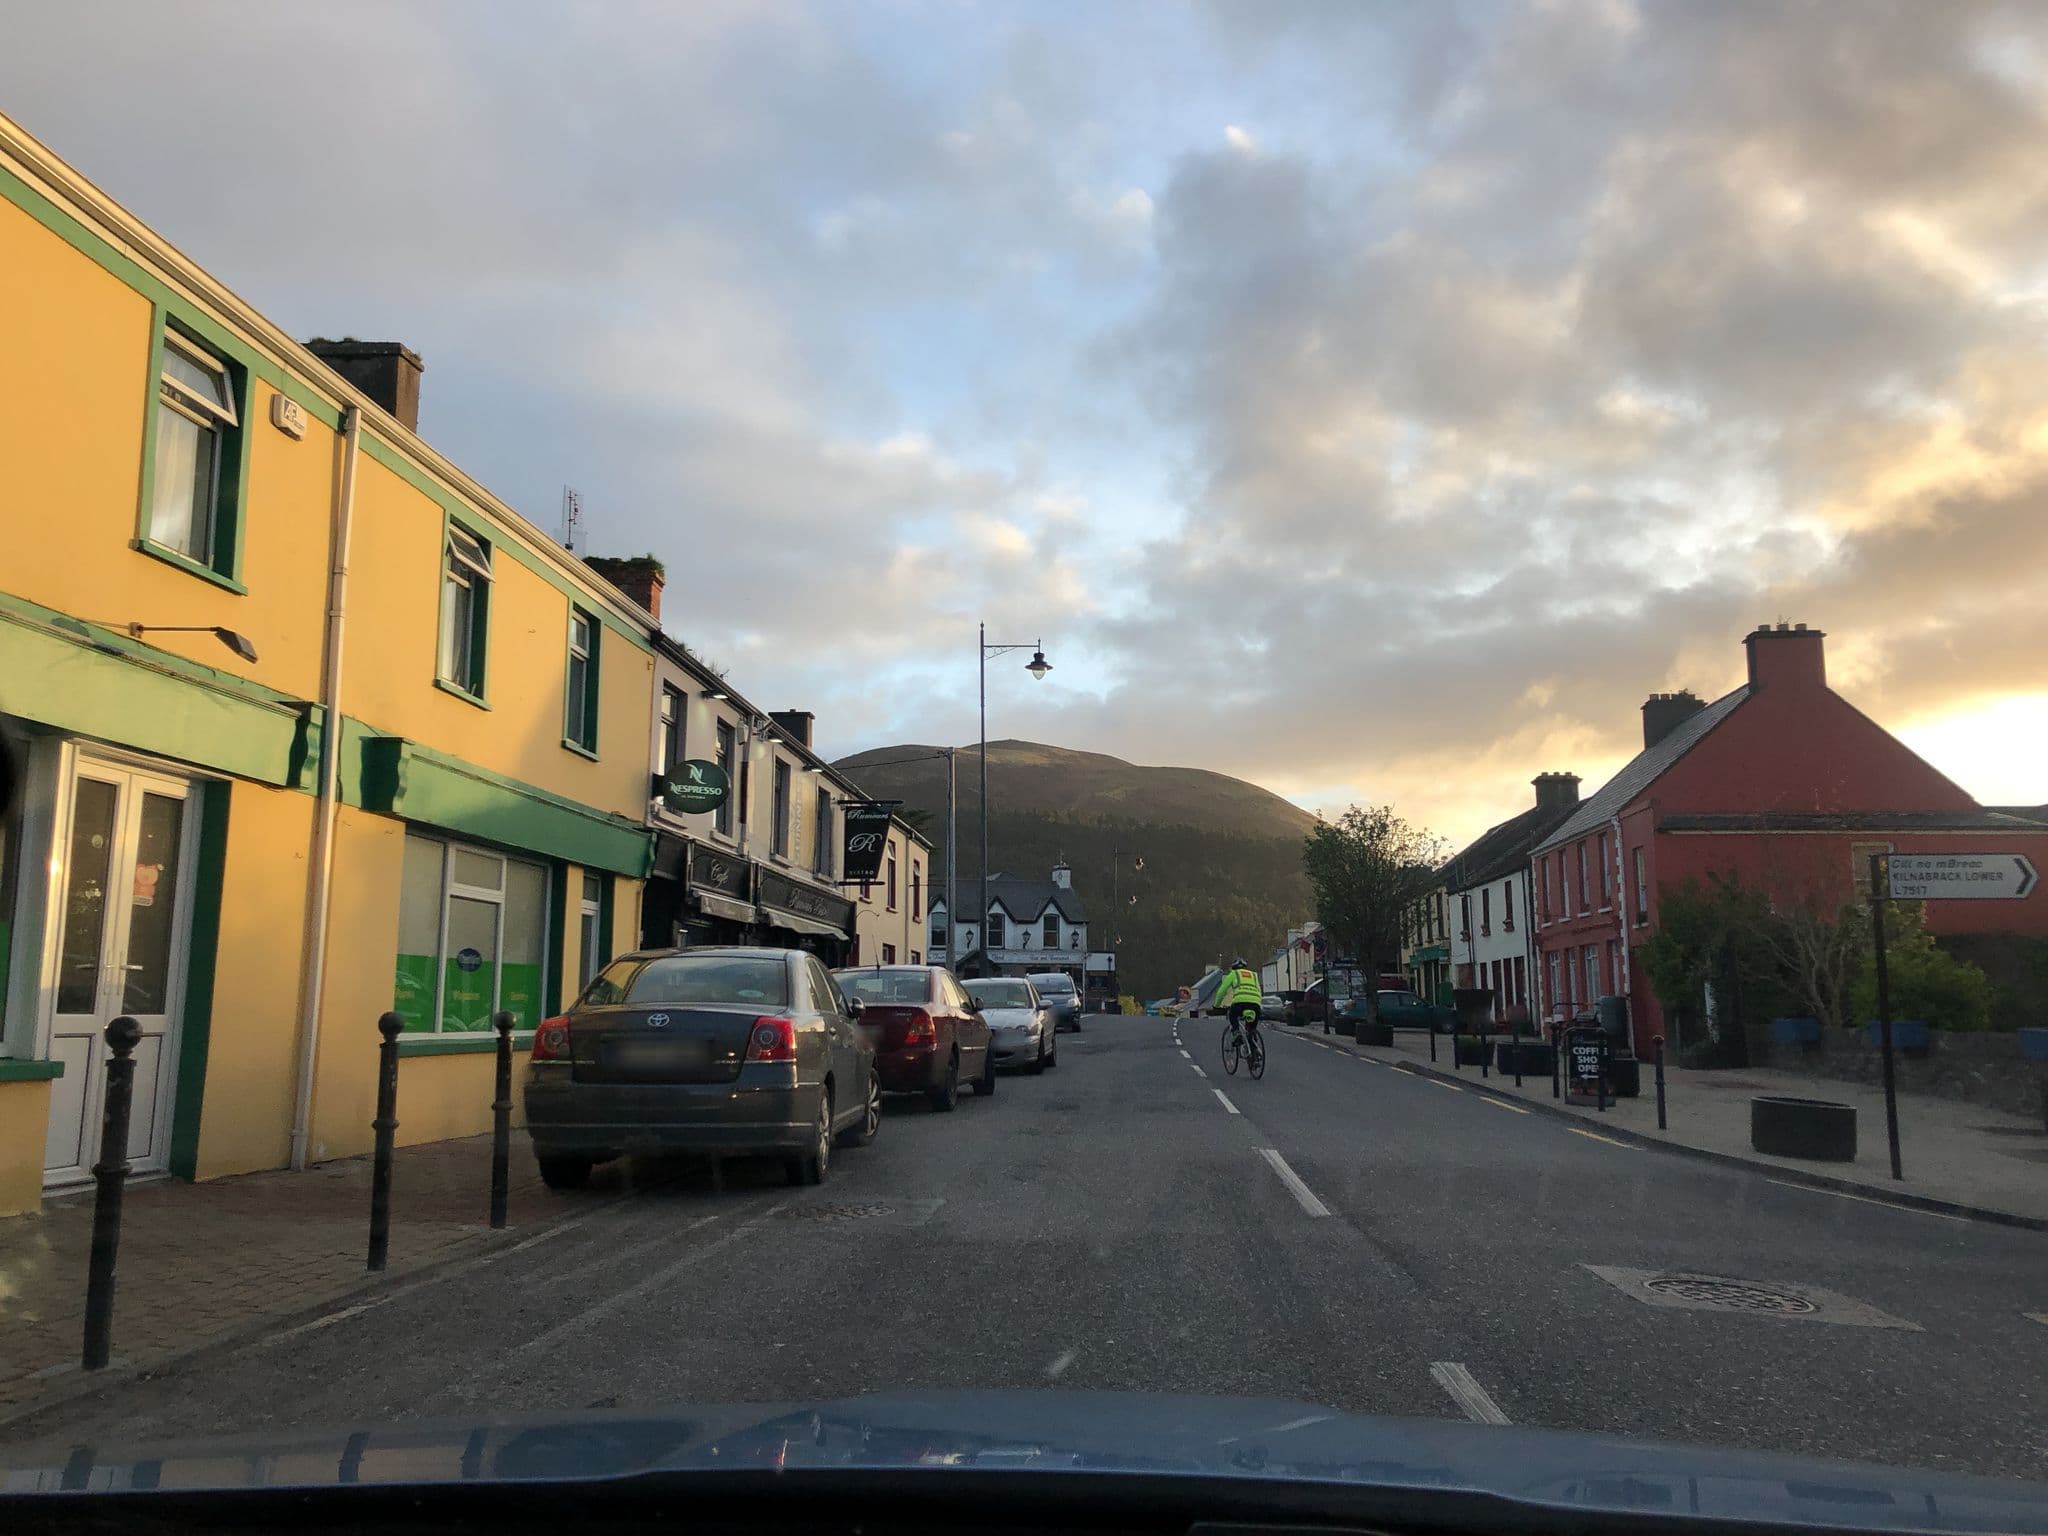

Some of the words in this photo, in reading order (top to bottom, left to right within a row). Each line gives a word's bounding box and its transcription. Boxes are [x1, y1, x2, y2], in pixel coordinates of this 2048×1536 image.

[668, 781, 722, 796] NESPRESSO
[848, 832, 882, 853] R
[1892, 871, 1961, 881] KILNABRACK
[1965, 871, 2004, 881] LOWER
[1894, 885, 1928, 895] L7517
[1572, 1046, 1608, 1055] COFF
[1577, 1055, 1599, 1064] SHO
[1578, 1064, 1600, 1073] OPE
